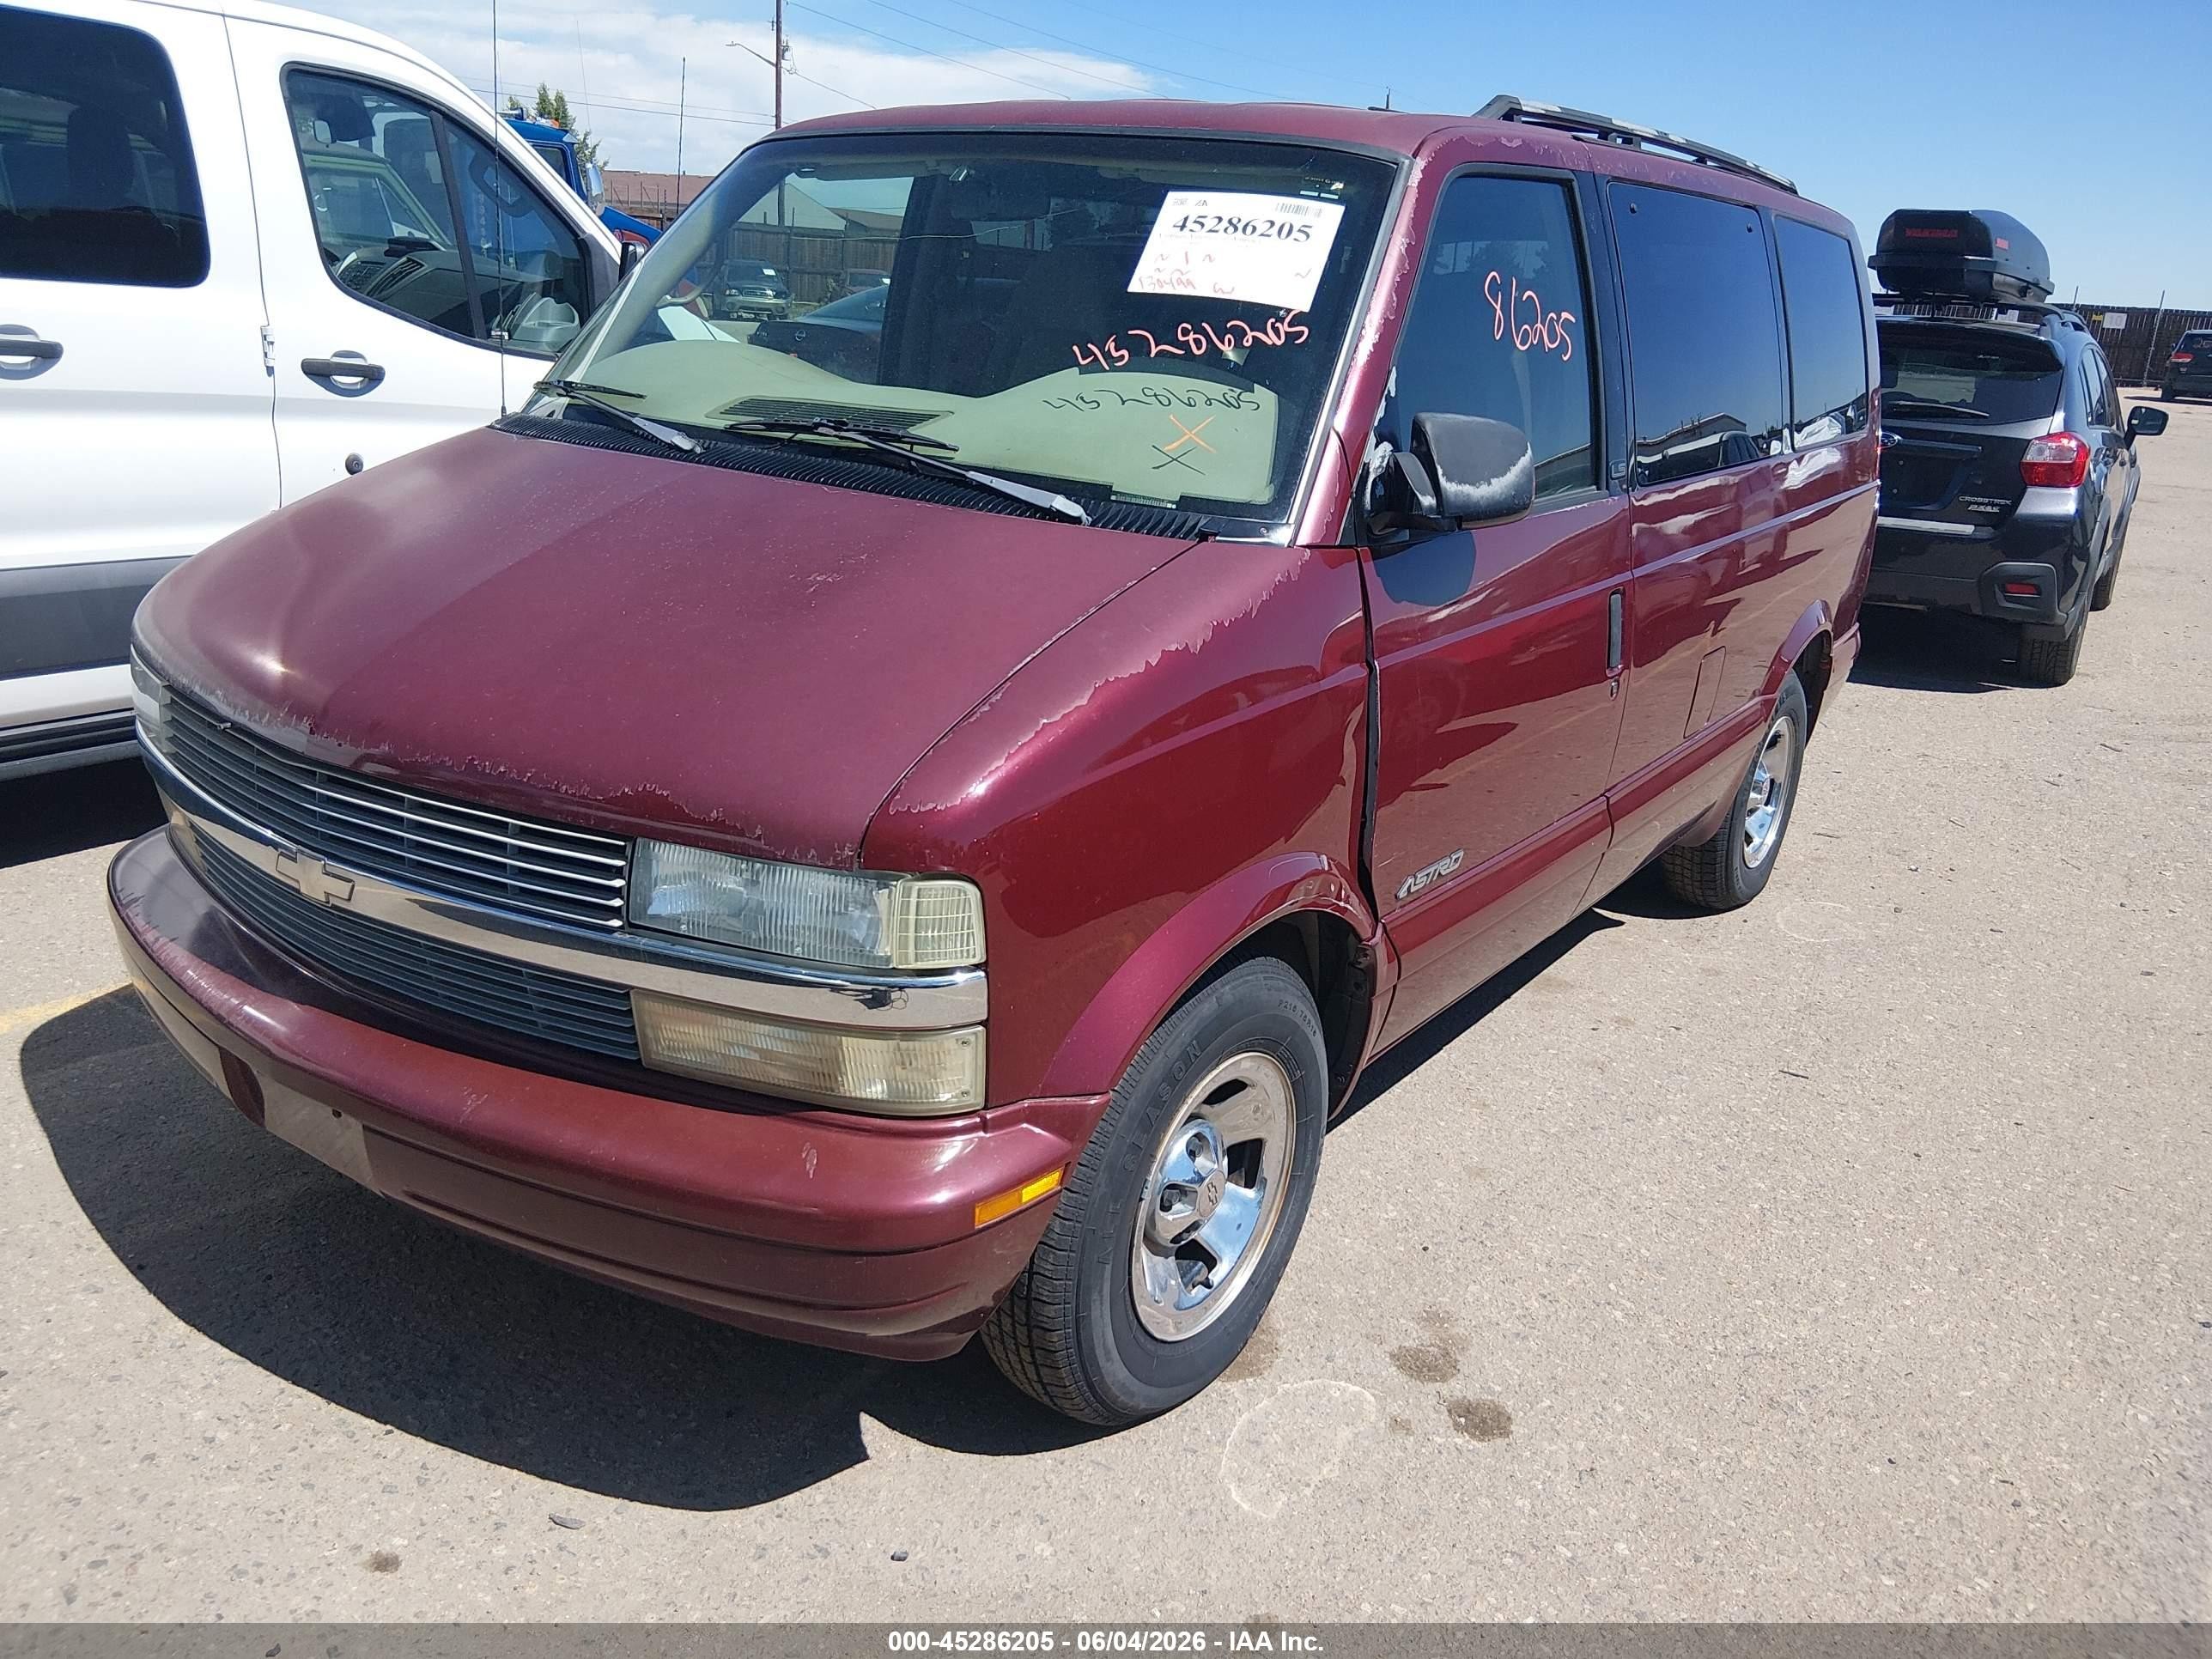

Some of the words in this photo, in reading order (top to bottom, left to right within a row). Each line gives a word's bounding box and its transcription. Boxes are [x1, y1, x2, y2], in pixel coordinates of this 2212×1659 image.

[1172, 214, 1315, 243] 45286205
[1073, 308, 1310, 370] 45286205
[1485, 270, 1576, 362] 86205
[1395, 848, 1464, 900] ASTRO
[1122, 1040, 1203, 1173] SEASON
